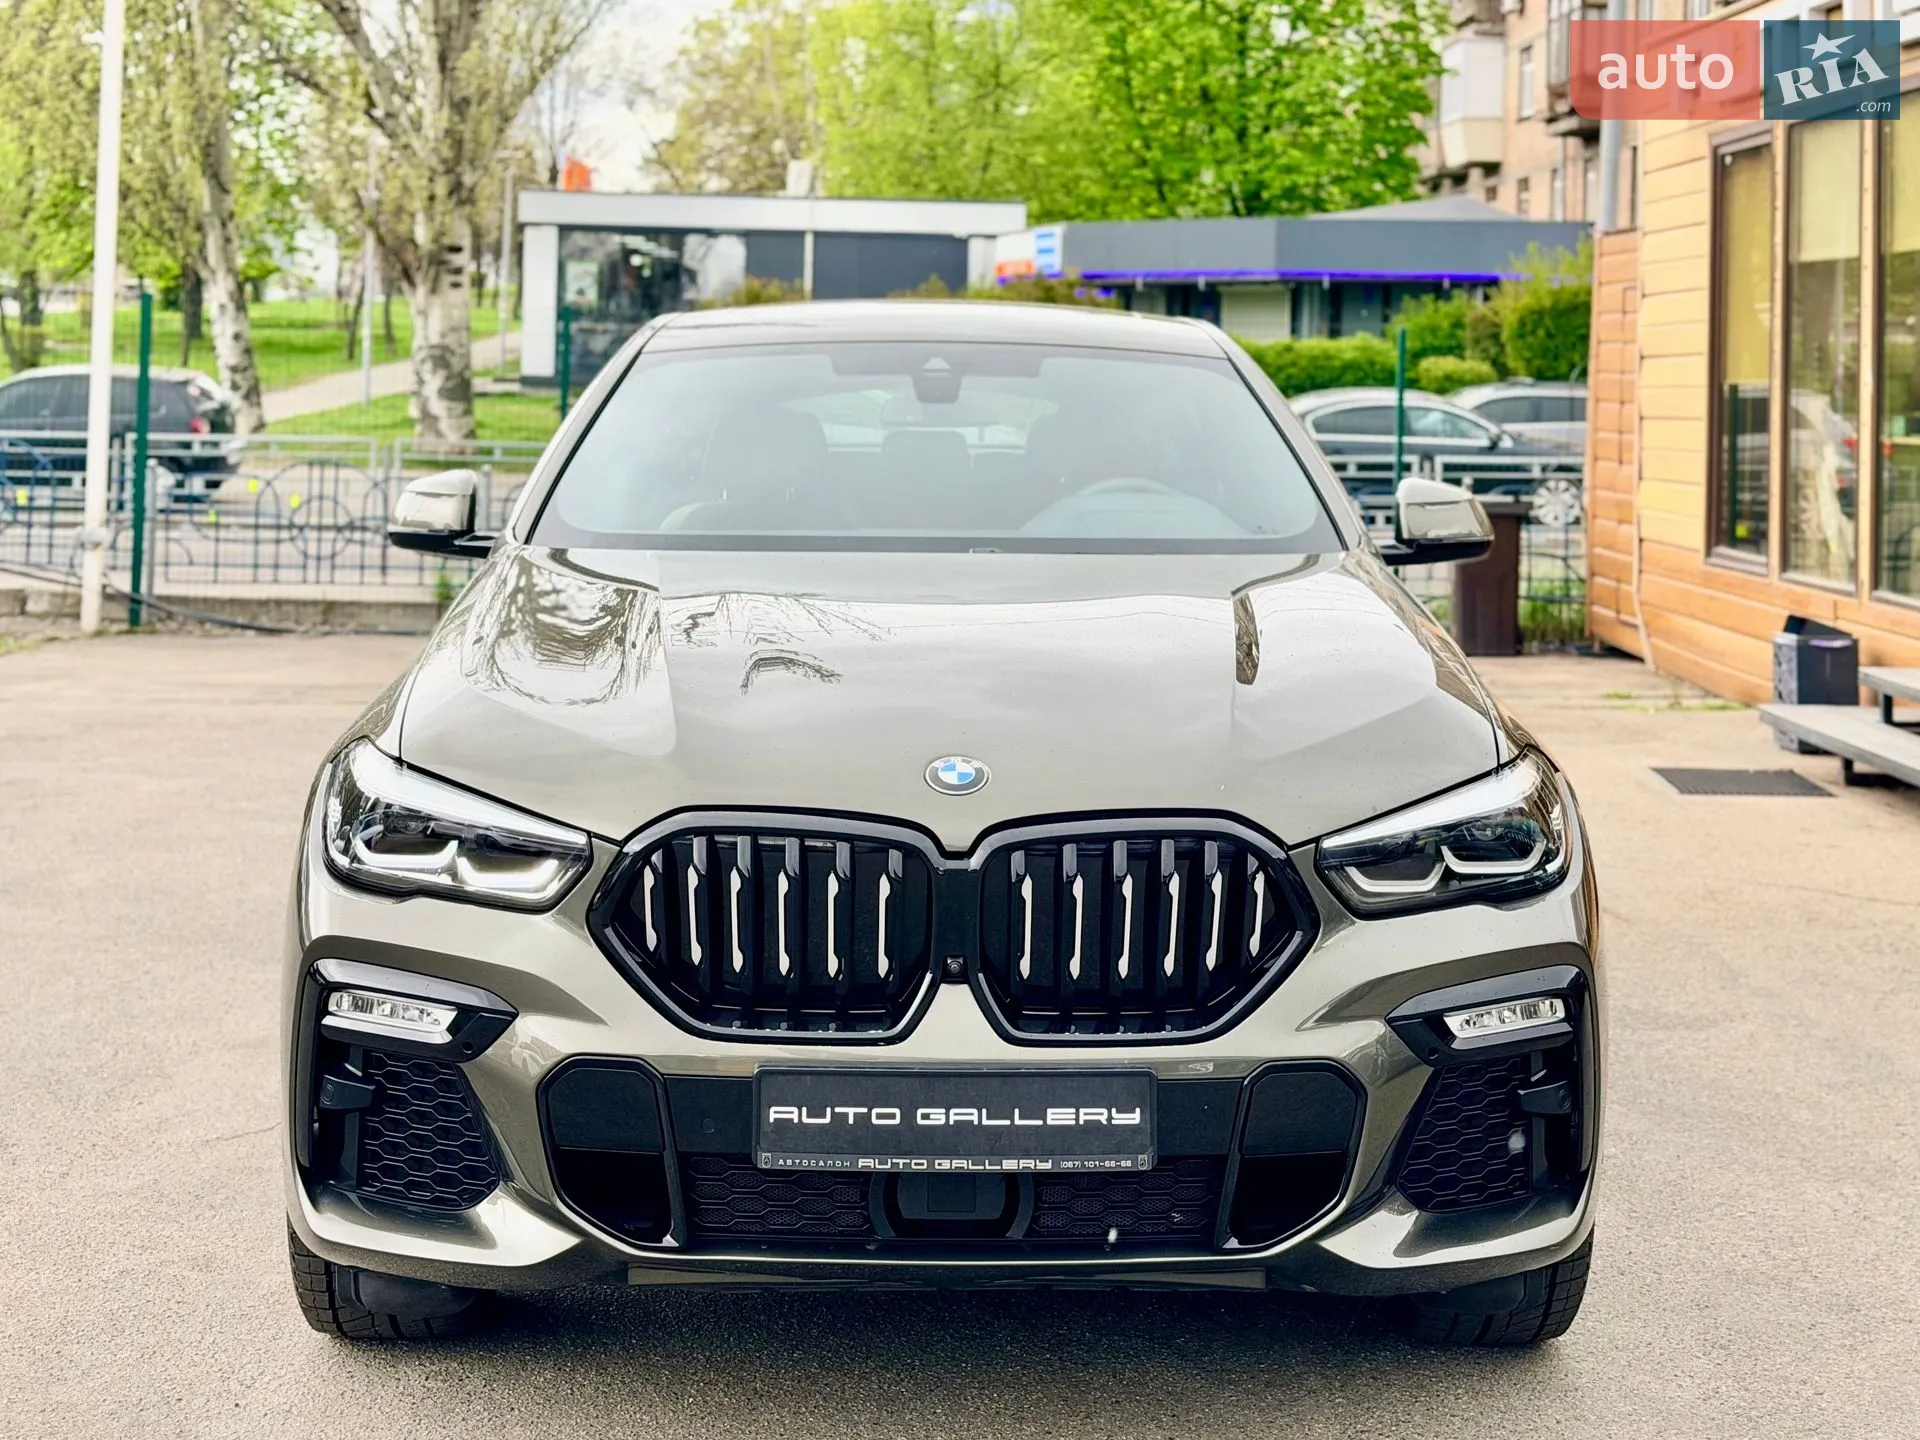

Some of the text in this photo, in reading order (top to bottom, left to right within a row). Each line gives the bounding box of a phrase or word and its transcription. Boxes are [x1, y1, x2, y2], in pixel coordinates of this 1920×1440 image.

[769, 1106, 1140, 1125] AUTO GALLERY
[778, 1159, 850, 1167] АВТОСАЛОН
[858, 1158, 927, 1170] AUTO
[934, 1158, 1052, 1170] GALLERY
